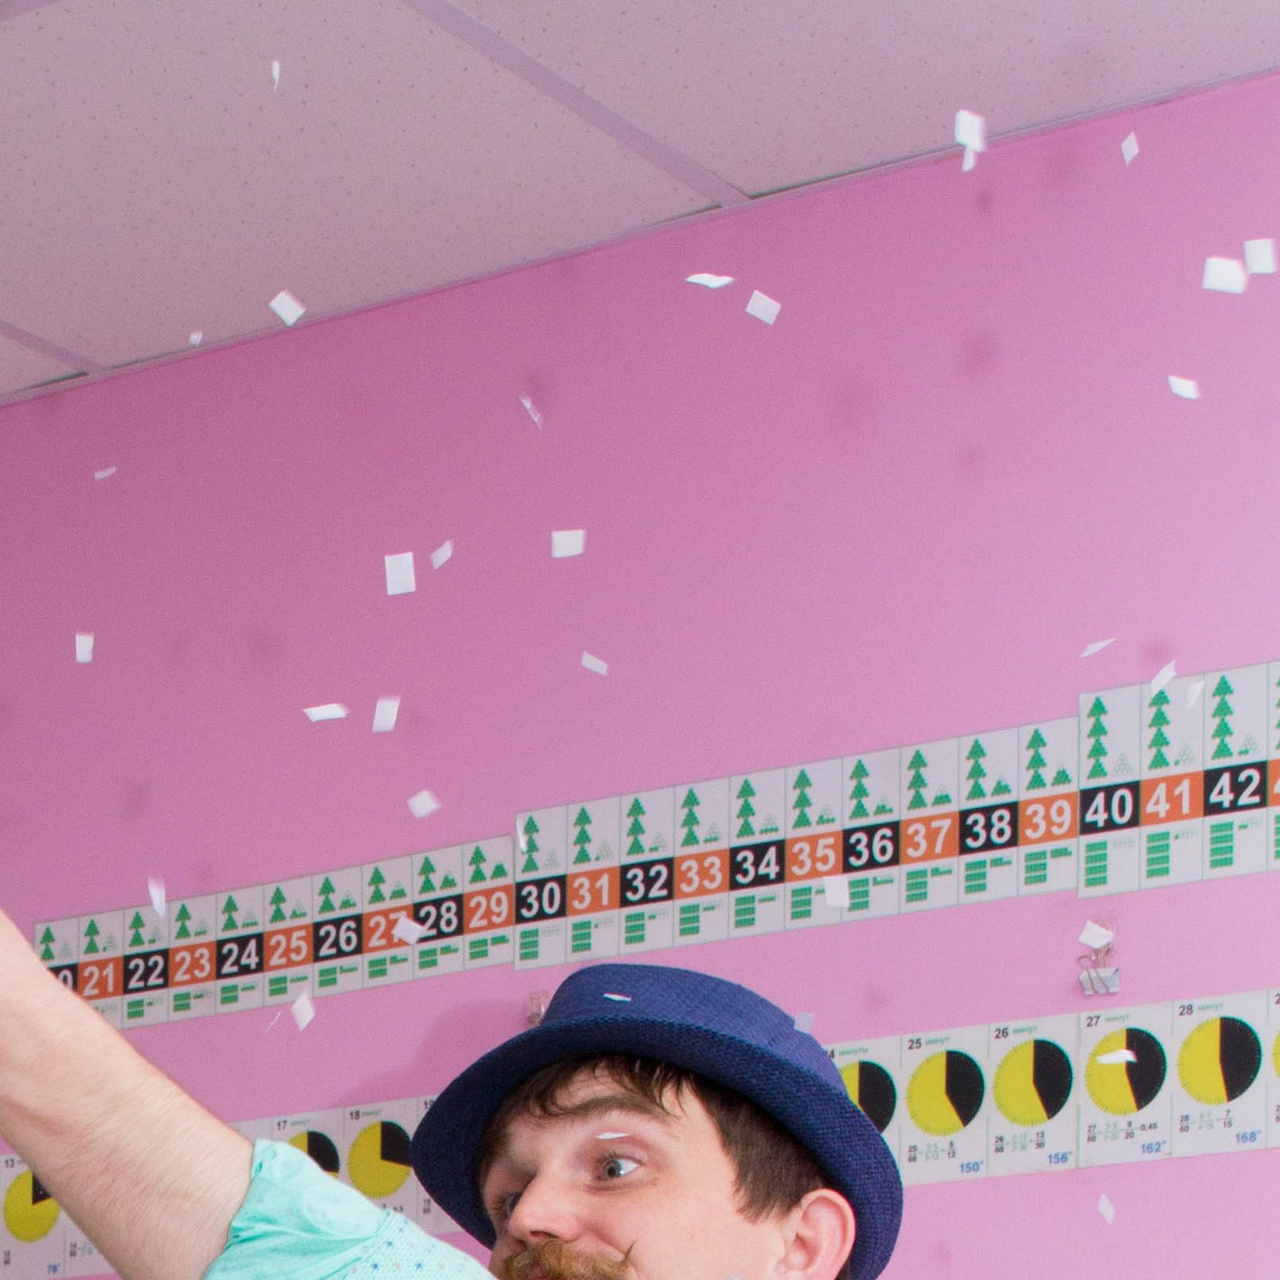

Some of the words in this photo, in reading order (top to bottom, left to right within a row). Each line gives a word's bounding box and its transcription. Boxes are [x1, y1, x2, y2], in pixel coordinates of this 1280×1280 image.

[83, 962, 115, 997] 21
[129, 955, 164, 990] 22
[175, 948, 211, 982] 23
[222, 942, 259, 973] 24
[268, 932, 307, 966] 25
[319, 922, 357, 957] 26
[418, 901, 458, 938] 28
[469, 891, 509, 927] 29
[520, 881, 562, 917] 30
[573, 876, 612, 911] 31
[626, 865, 669, 901] 32
[680, 858, 723, 893] 33
[736, 847, 780, 884] 34
[791, 841, 836, 878] 35
[849, 828, 893, 865] 36
[907, 820, 952, 858] 37
[966, 809, 1011, 847] 38
[1026, 800, 1072, 838] 39
[1086, 791, 1134, 828] 40
[1147, 781, 1193, 818] 41
[1211, 769, 1261, 809] 42
[1179, 1005, 1193, 1015] 28
[1086, 1016, 1099, 1027] 27
[995, 1028, 1008, 1039] 26
[908, 1039, 922, 1050] 25
[350, 1110, 360, 1120] 18
[277, 1120, 287, 1130] 17
[5, 1159, 14, 1168] 13
